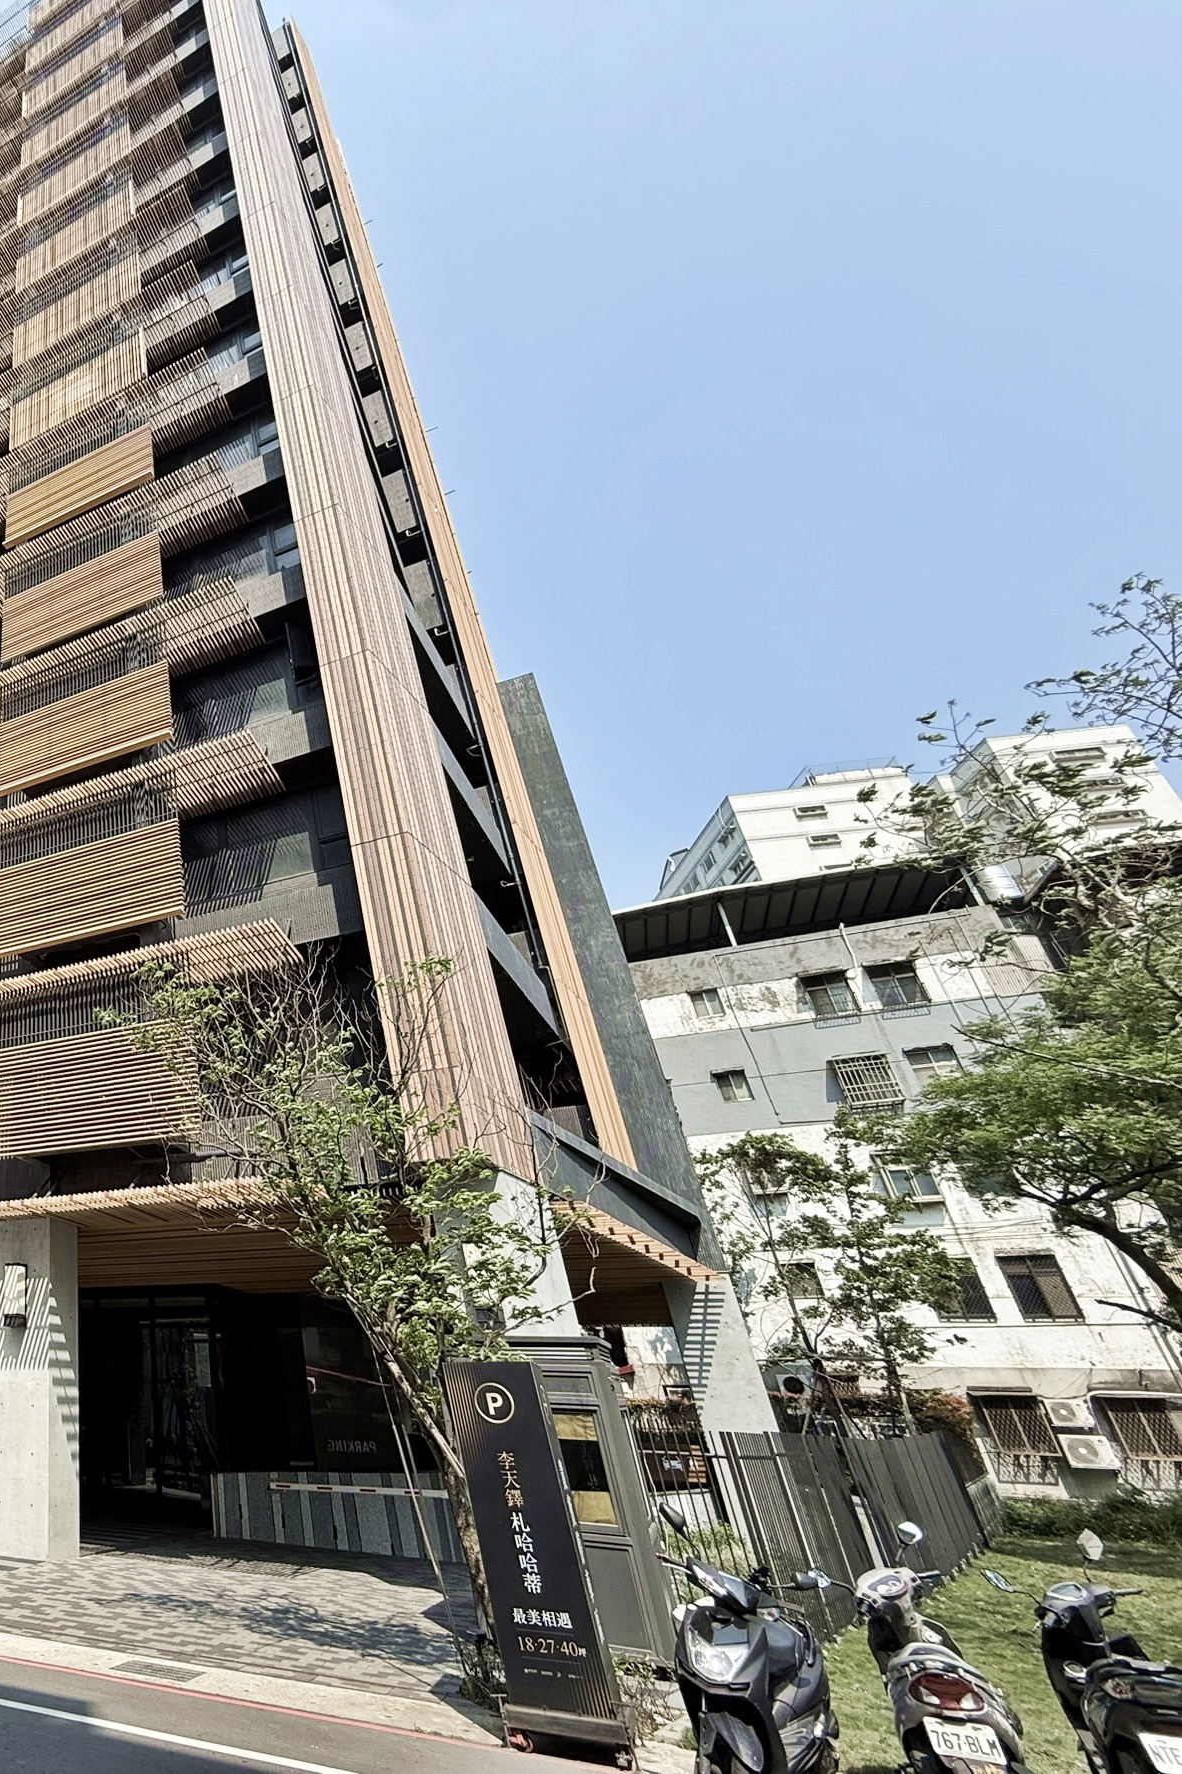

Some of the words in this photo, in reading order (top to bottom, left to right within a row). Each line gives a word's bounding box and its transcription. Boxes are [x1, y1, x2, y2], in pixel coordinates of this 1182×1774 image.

[485, 1392, 503, 1415] P
[512, 1607, 573, 1629] 最美相遇
